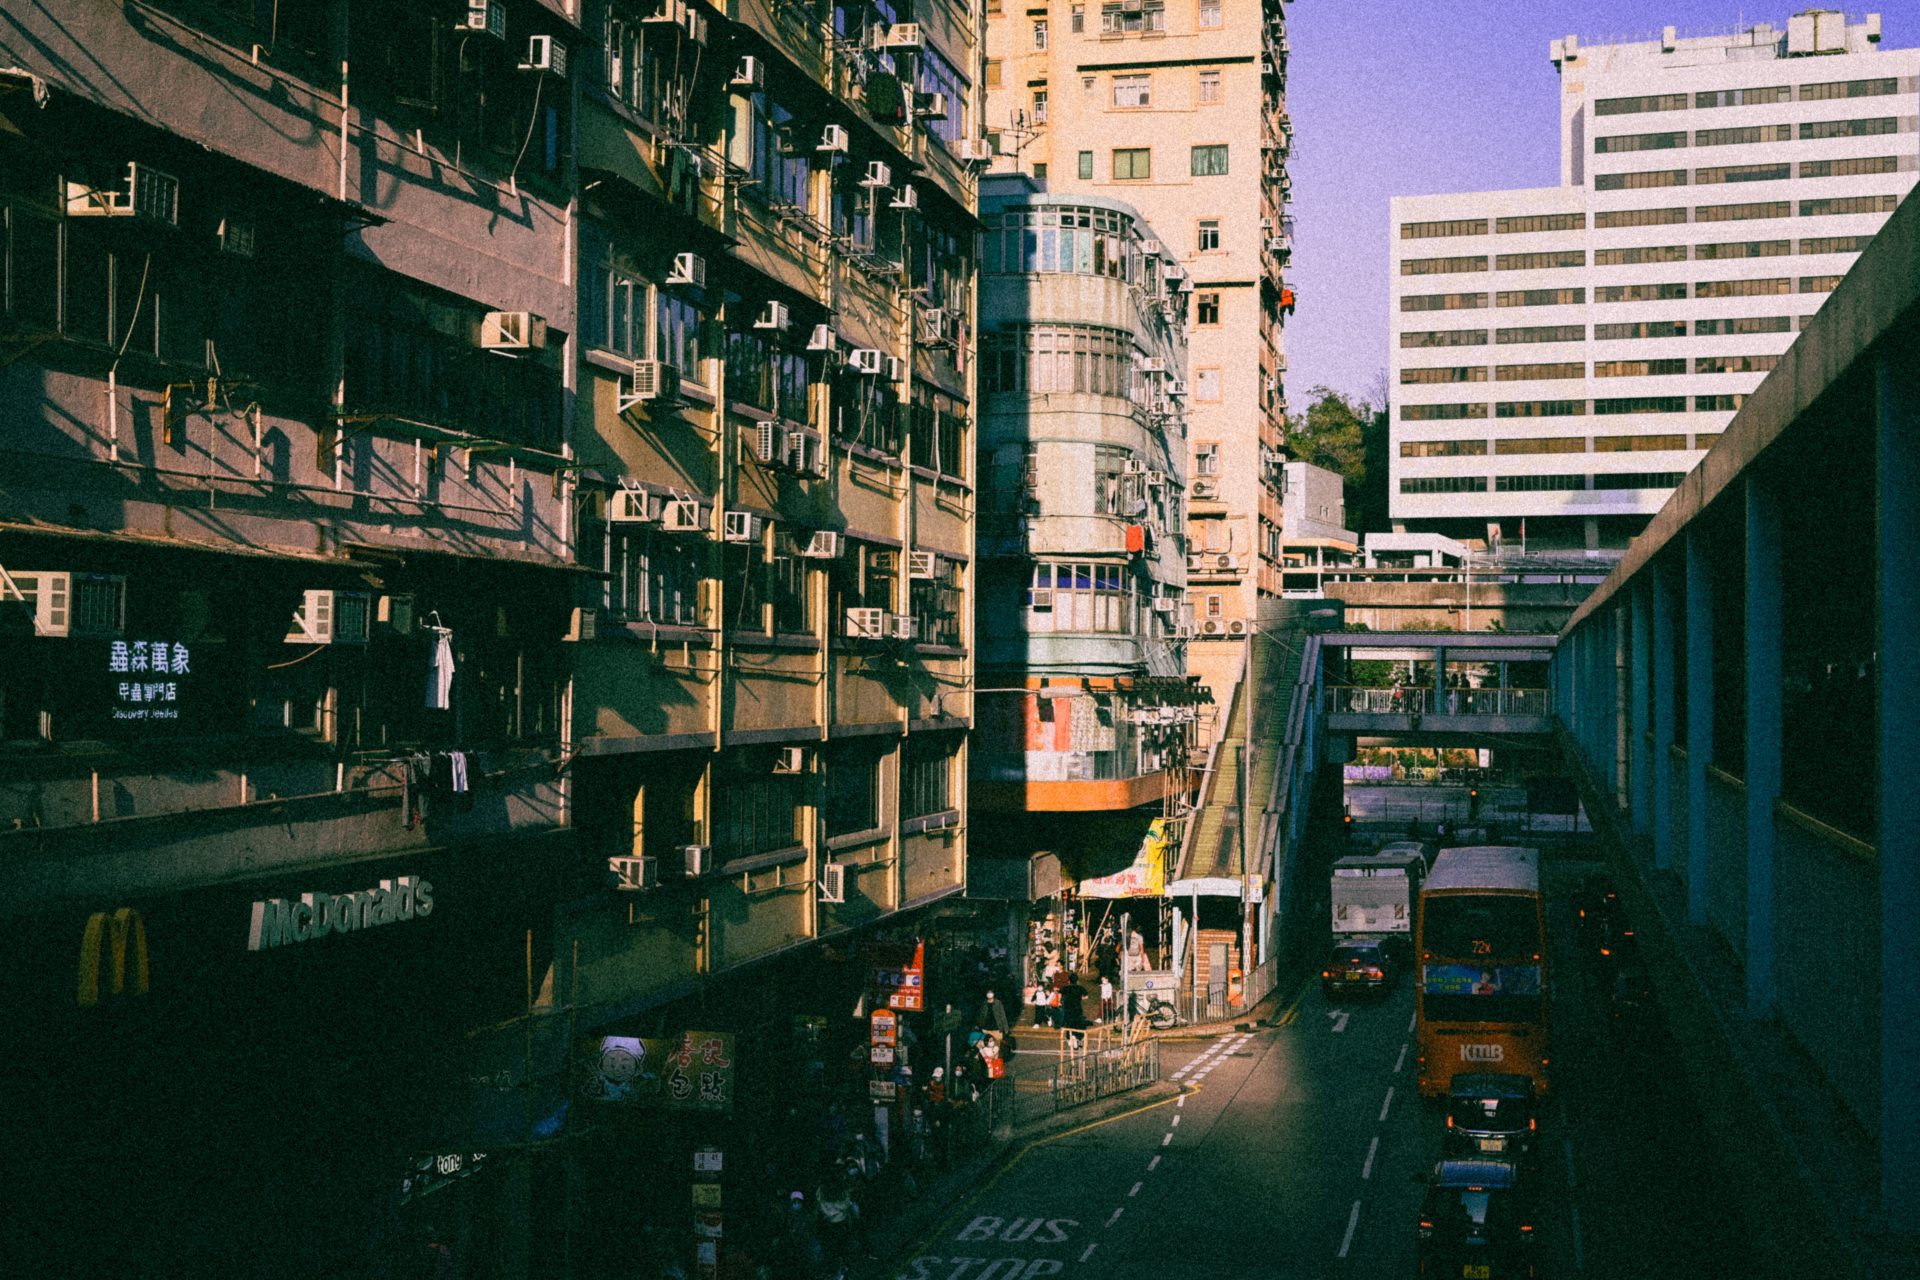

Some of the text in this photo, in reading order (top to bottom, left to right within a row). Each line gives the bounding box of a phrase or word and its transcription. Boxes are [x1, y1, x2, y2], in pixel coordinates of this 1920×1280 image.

[248, 875, 433, 950] McDonald's
[1460, 1044, 1504, 1061] KMB
[955, 1216, 1079, 1243] BUS
[896, 1256, 1064, 1280] STOP
